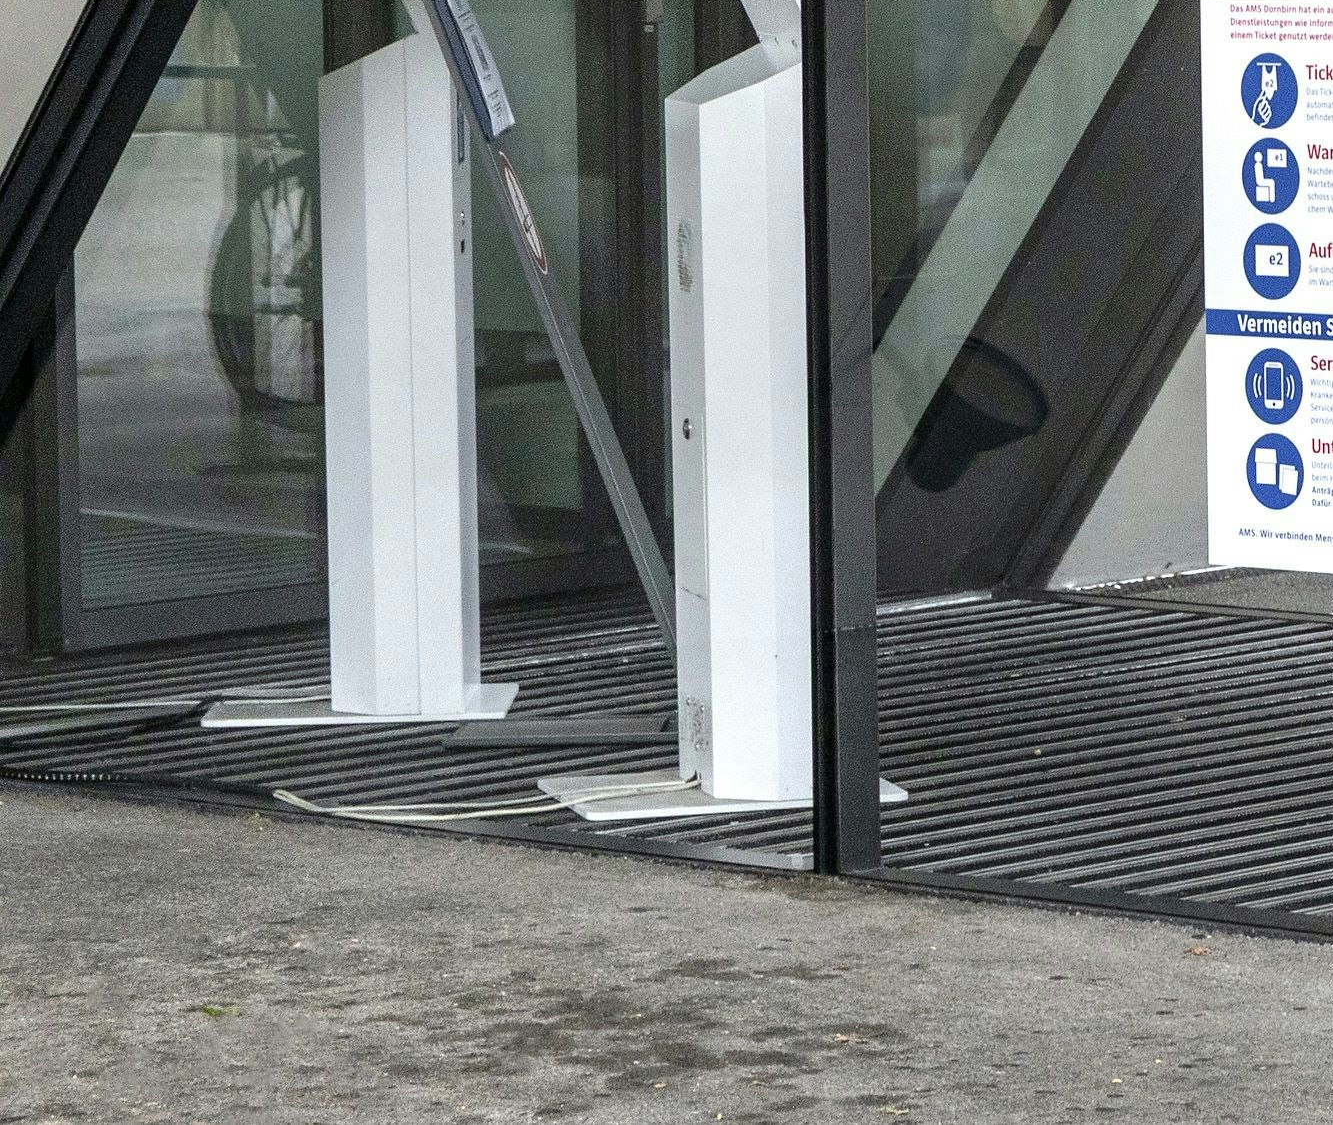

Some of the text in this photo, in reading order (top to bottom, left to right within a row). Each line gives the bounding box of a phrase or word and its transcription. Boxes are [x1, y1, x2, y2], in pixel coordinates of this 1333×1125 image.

[1230, 4, 1243, 13] Das
[1245, 5, 1262, 13] AMS
[1264, 5, 1296, 13] Dornbirn
[1299, 5, 1311, 14] hat
[1313, 6, 1325, 14] ein
[1230, 17, 1293, 28] Dienstleistungen
[1295, 19, 1307, 27] wie
[1255, 31, 1277, 40] Ticket
[1279, 32, 1307, 42] genutzt
[1265, 79, 1274, 88] e2
[1275, 153, 1283, 161] e1
[1269, 253, 1283, 265] e2
[1237, 314, 1322, 336] Vermeiden
[1312, 499, 1331, 507] Dafür
[1238, 528, 1258, 537] AMS.
[1260, 529, 1273, 538] Wir
[1275, 531, 1313, 542] verbinden
